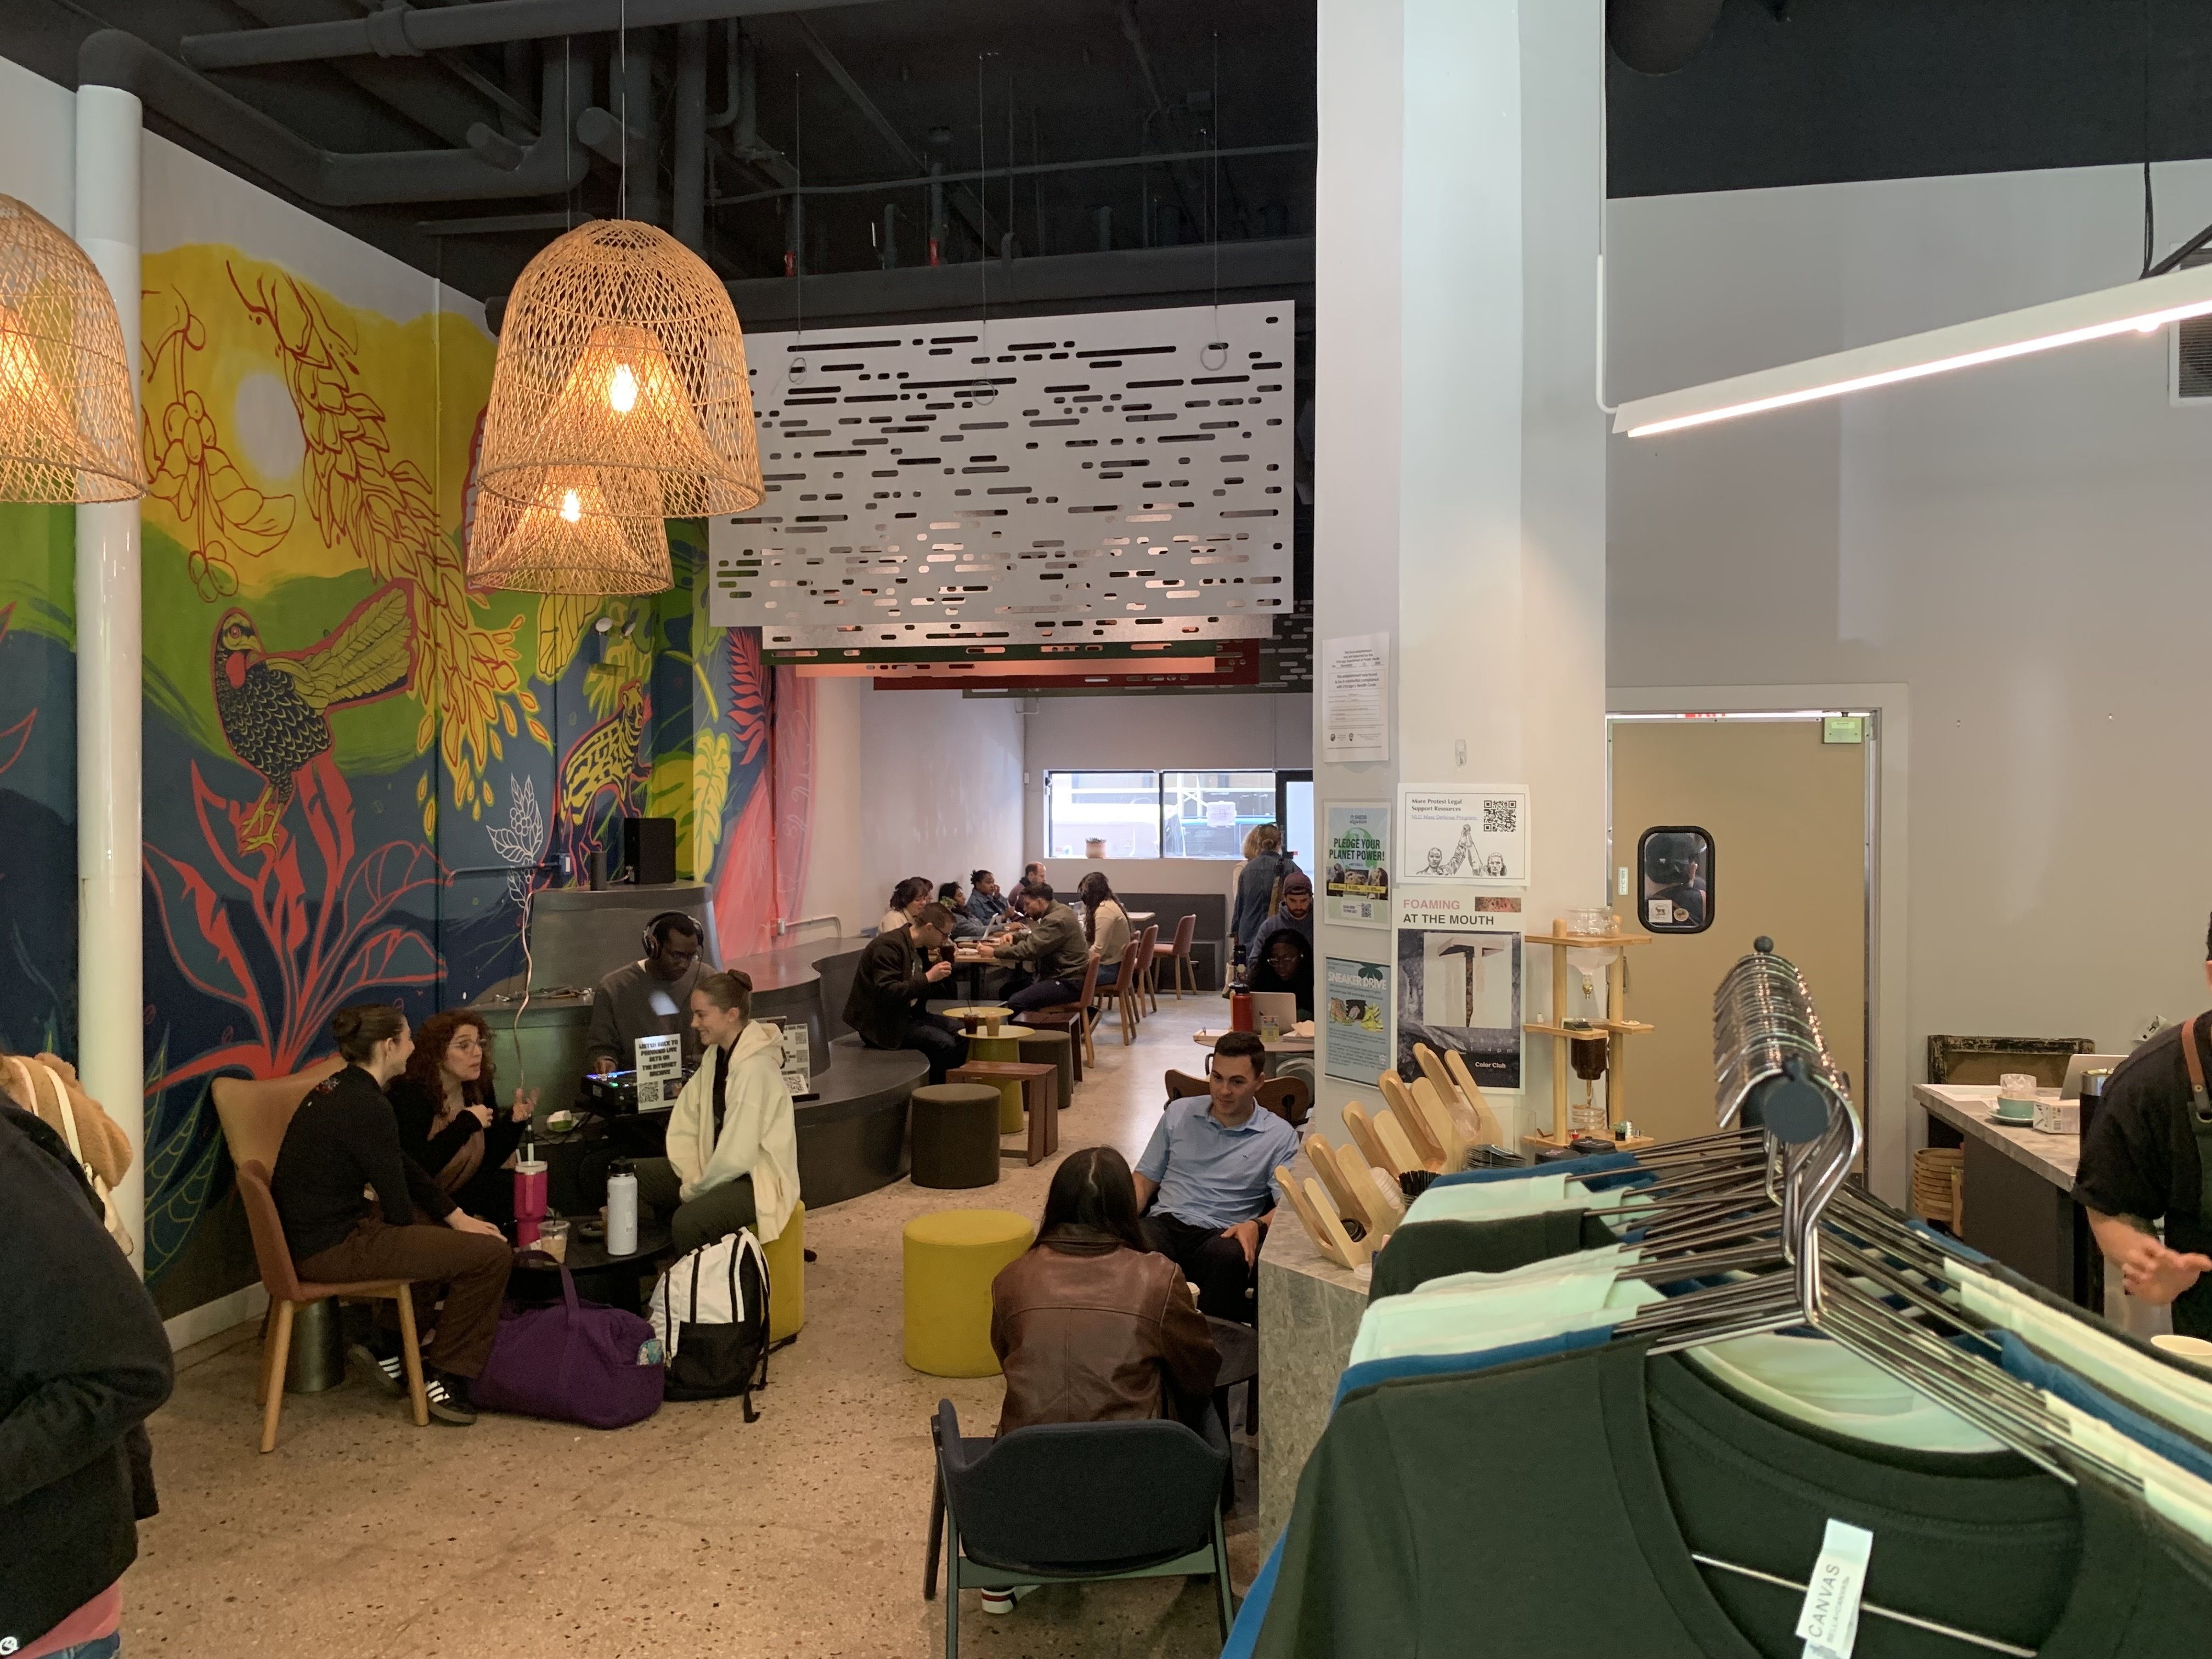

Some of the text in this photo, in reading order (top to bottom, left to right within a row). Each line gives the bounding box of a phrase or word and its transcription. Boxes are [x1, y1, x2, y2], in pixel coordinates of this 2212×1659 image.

[1334, 838, 1380, 849] PLEDGE YOUR
[1329, 849, 1385, 861] PLANET POWER!
[1403, 899, 1460, 910] FOAMING
[1403, 913, 1494, 925] AT THE MOUTH
[1328, 971, 1362, 986] SNEAKER
[1363, 977, 1387, 990] DRIVE
[1808, 1564, 1839, 1638] CANVAS
